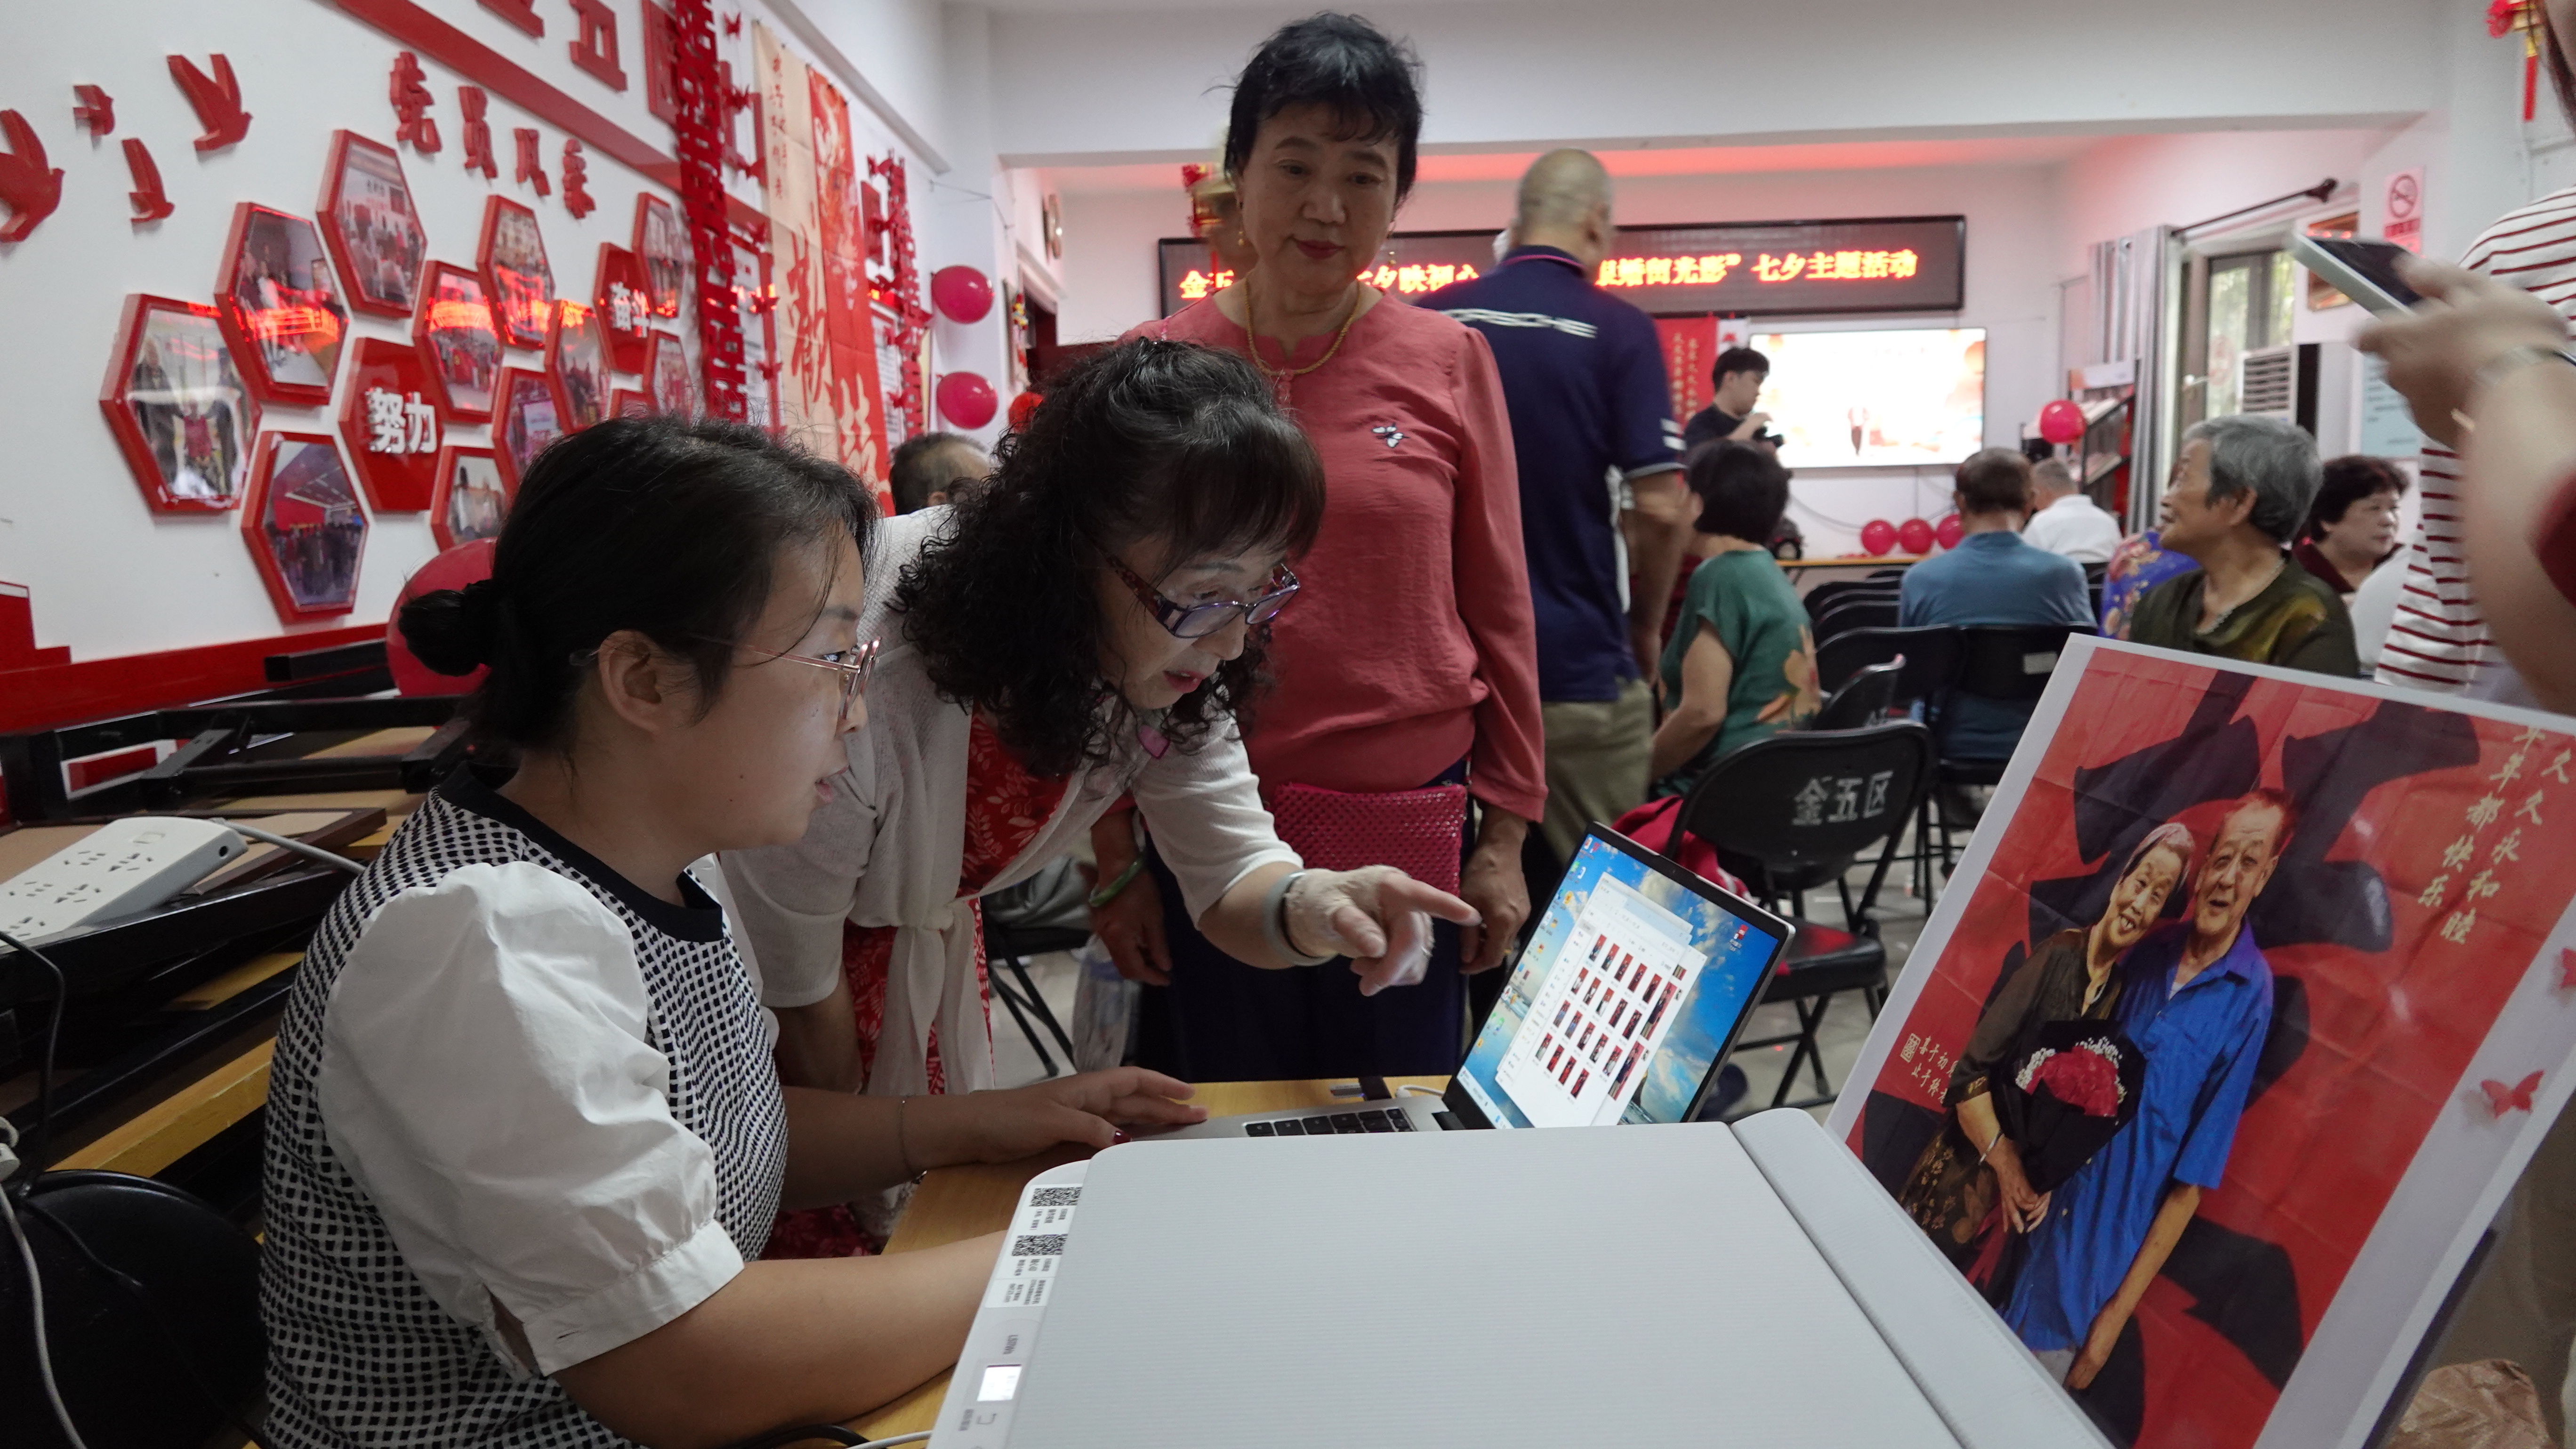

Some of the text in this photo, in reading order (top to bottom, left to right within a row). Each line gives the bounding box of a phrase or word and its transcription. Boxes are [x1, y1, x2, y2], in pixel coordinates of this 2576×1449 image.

[1750, 249, 1917, 283] 七夕主题活动
[610, 282, 651, 338] 奋斗
[365, 386, 437, 453] 努力
[2440, 748, 2572, 945] 久久永和睦
